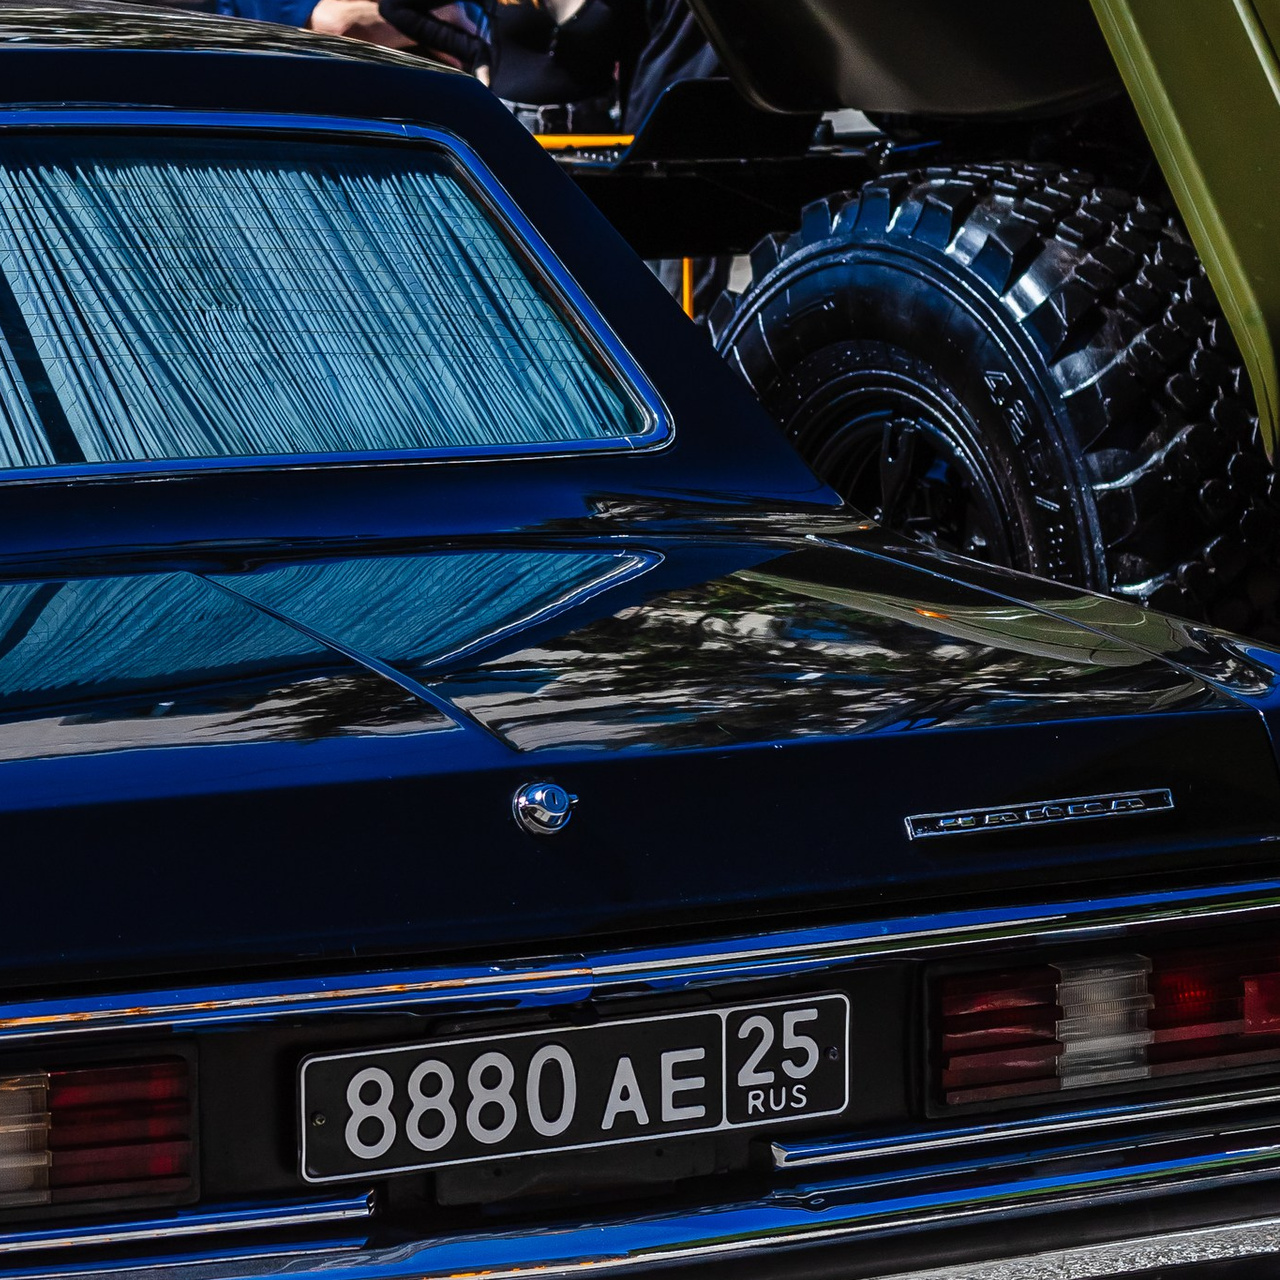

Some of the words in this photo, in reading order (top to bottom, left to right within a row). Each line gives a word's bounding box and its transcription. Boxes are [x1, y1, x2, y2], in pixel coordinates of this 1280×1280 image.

[737, 1008, 820, 1087] 25
[344, 1044, 577, 1160] 8880
[601, 1047, 706, 1130] AE
[747, 1084, 807, 1115] RUS
